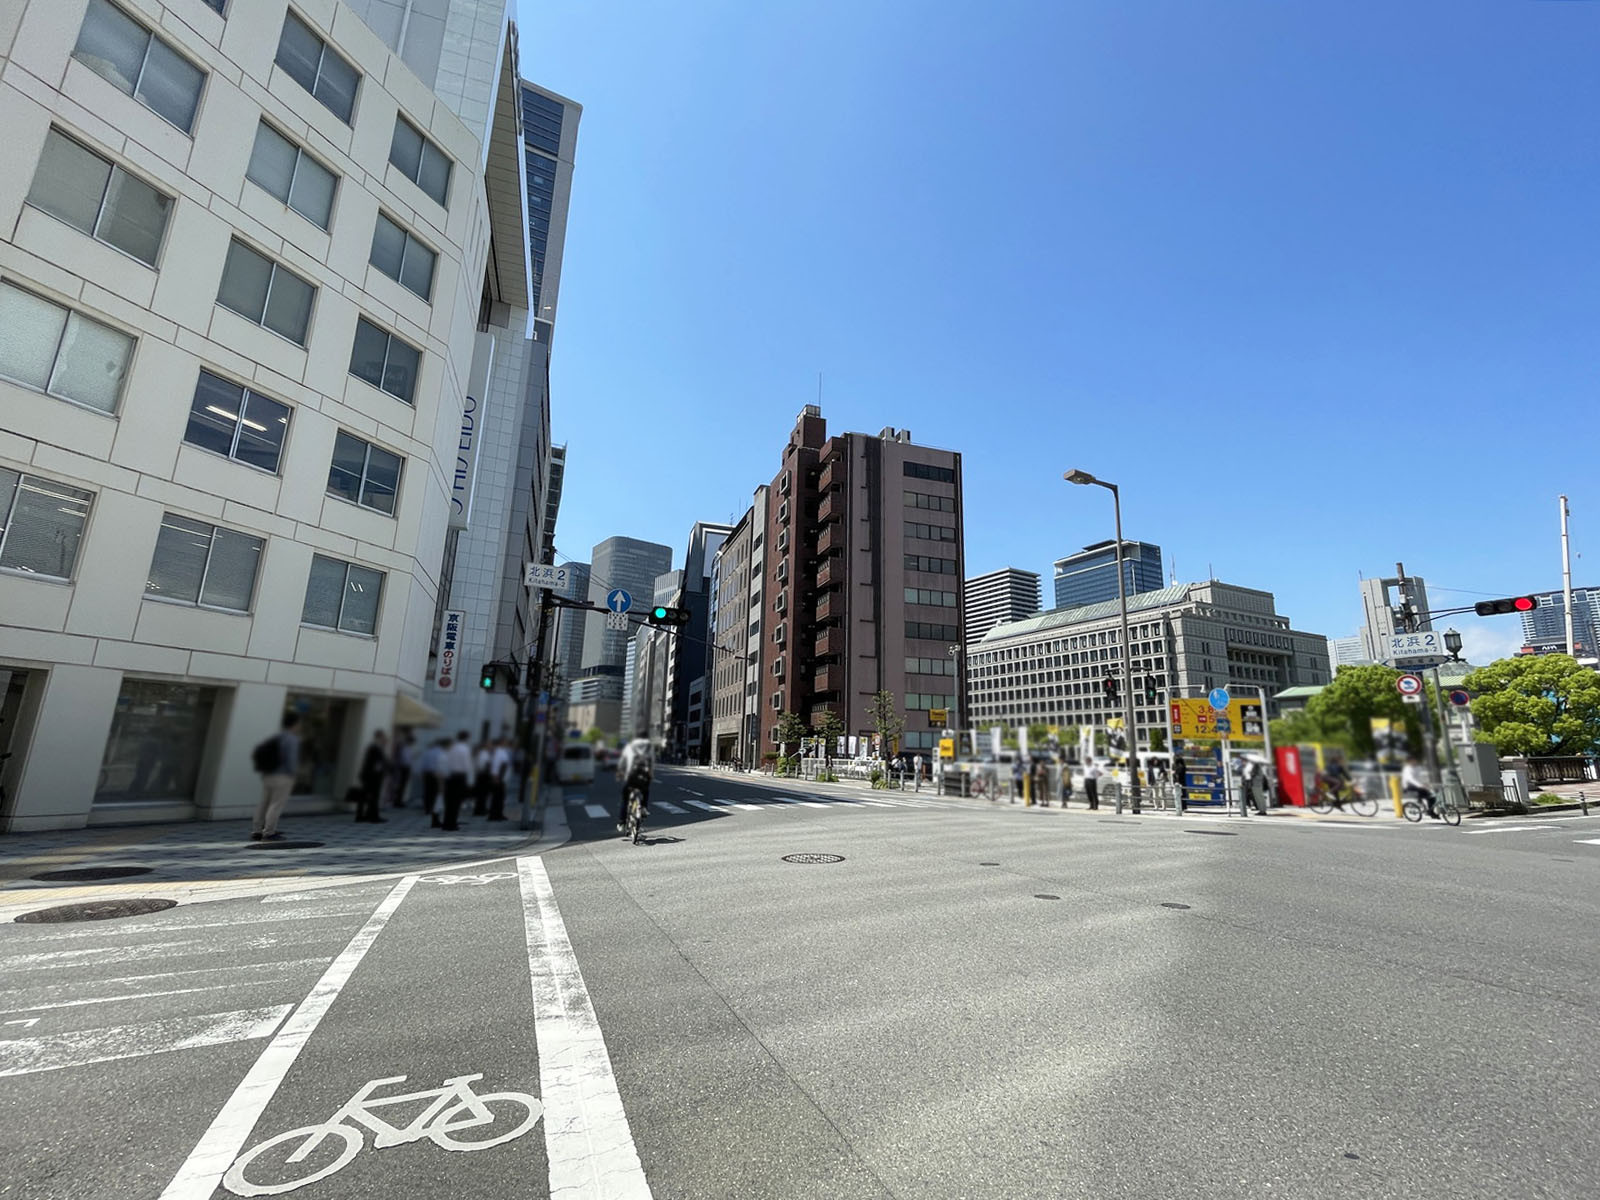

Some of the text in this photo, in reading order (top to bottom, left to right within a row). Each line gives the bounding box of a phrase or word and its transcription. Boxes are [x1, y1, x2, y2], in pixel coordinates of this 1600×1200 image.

[529, 566, 566, 581] 北浜2
[441, 613, 460, 676] 京阪電車のりば
[1391, 633, 1436, 649] 北浜2
[1393, 646, 1438, 656] Kitahama-2
